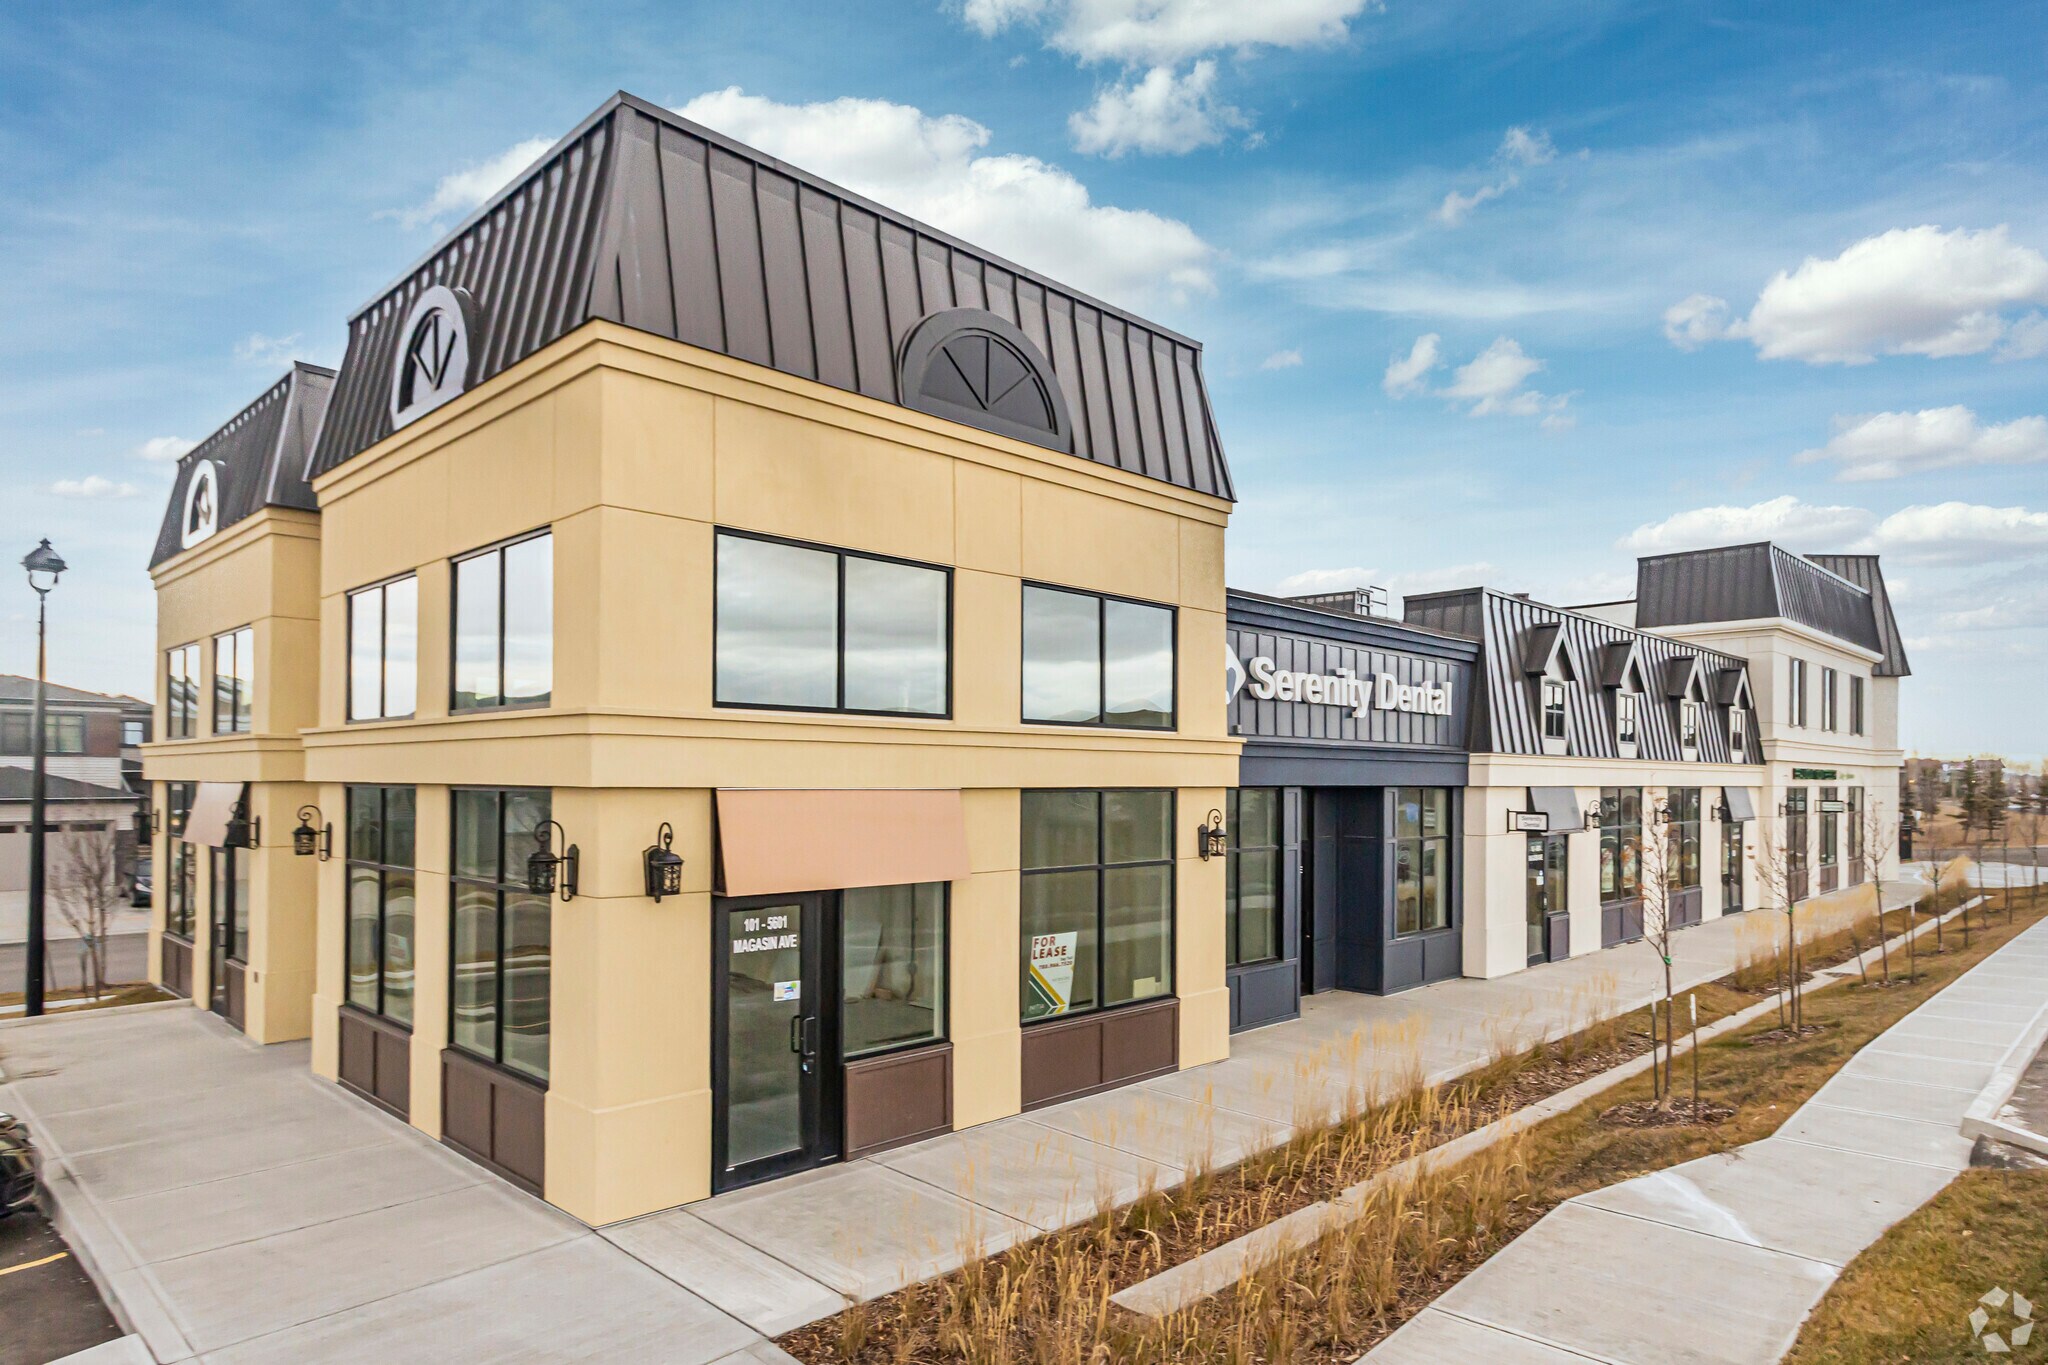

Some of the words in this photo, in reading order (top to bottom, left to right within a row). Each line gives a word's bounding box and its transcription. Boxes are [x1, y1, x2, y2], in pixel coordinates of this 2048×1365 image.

[1248, 656, 1373, 718] Serenity
[1375, 672, 1452, 716] Dental
[744, 918, 760, 932] 101
[733, 936, 778, 953] MAGASIN
[778, 934, 798, 949] AVE
[1033, 936, 1056, 949] FOR
[1032, 945, 1068, 960] LEASE
